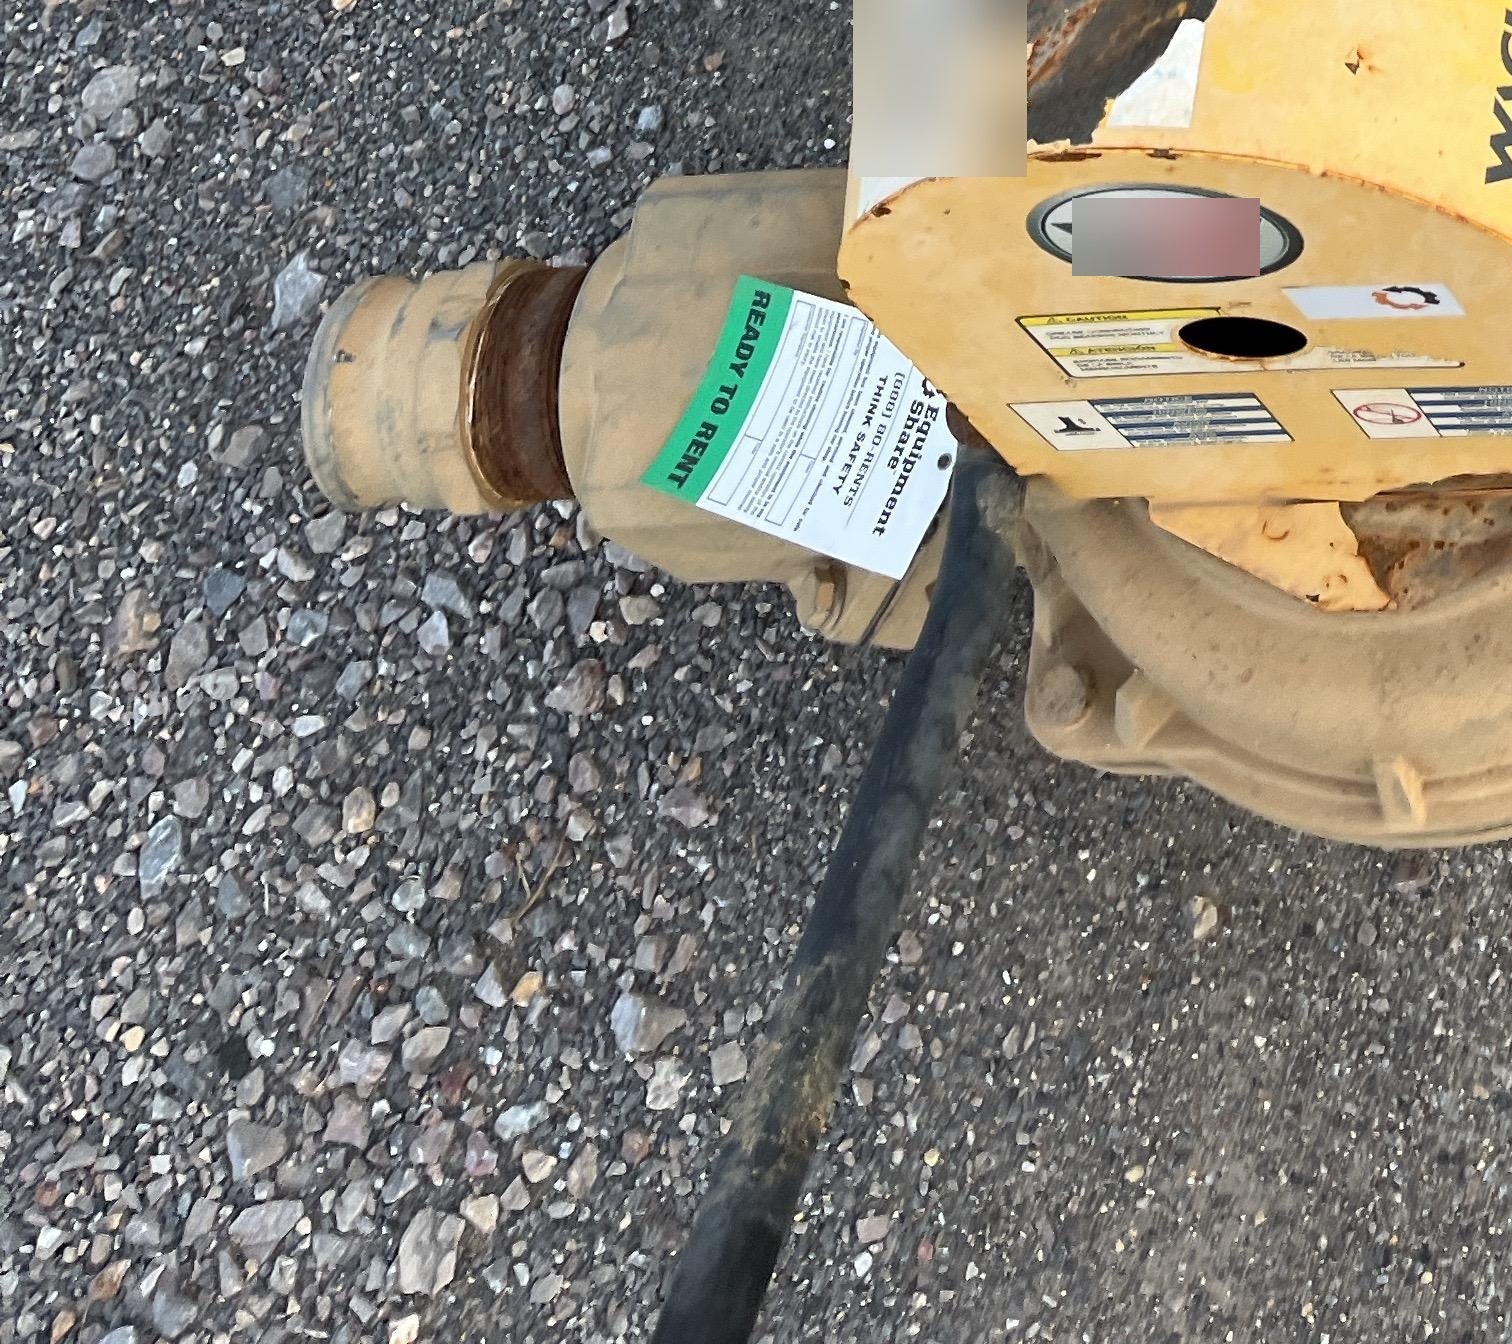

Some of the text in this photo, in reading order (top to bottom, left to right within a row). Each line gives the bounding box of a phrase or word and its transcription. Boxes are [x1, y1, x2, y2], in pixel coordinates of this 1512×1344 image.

[1066, 314, 1128, 322] CAUTION
[666, 289, 772, 489] READY TO RENT
[832, 375, 889, 497] THINK SAFETY
[887, 399, 924, 471] Share
[843, 423, 888, 507] 80-RENTS
[872, 403, 940, 537] Equipment
